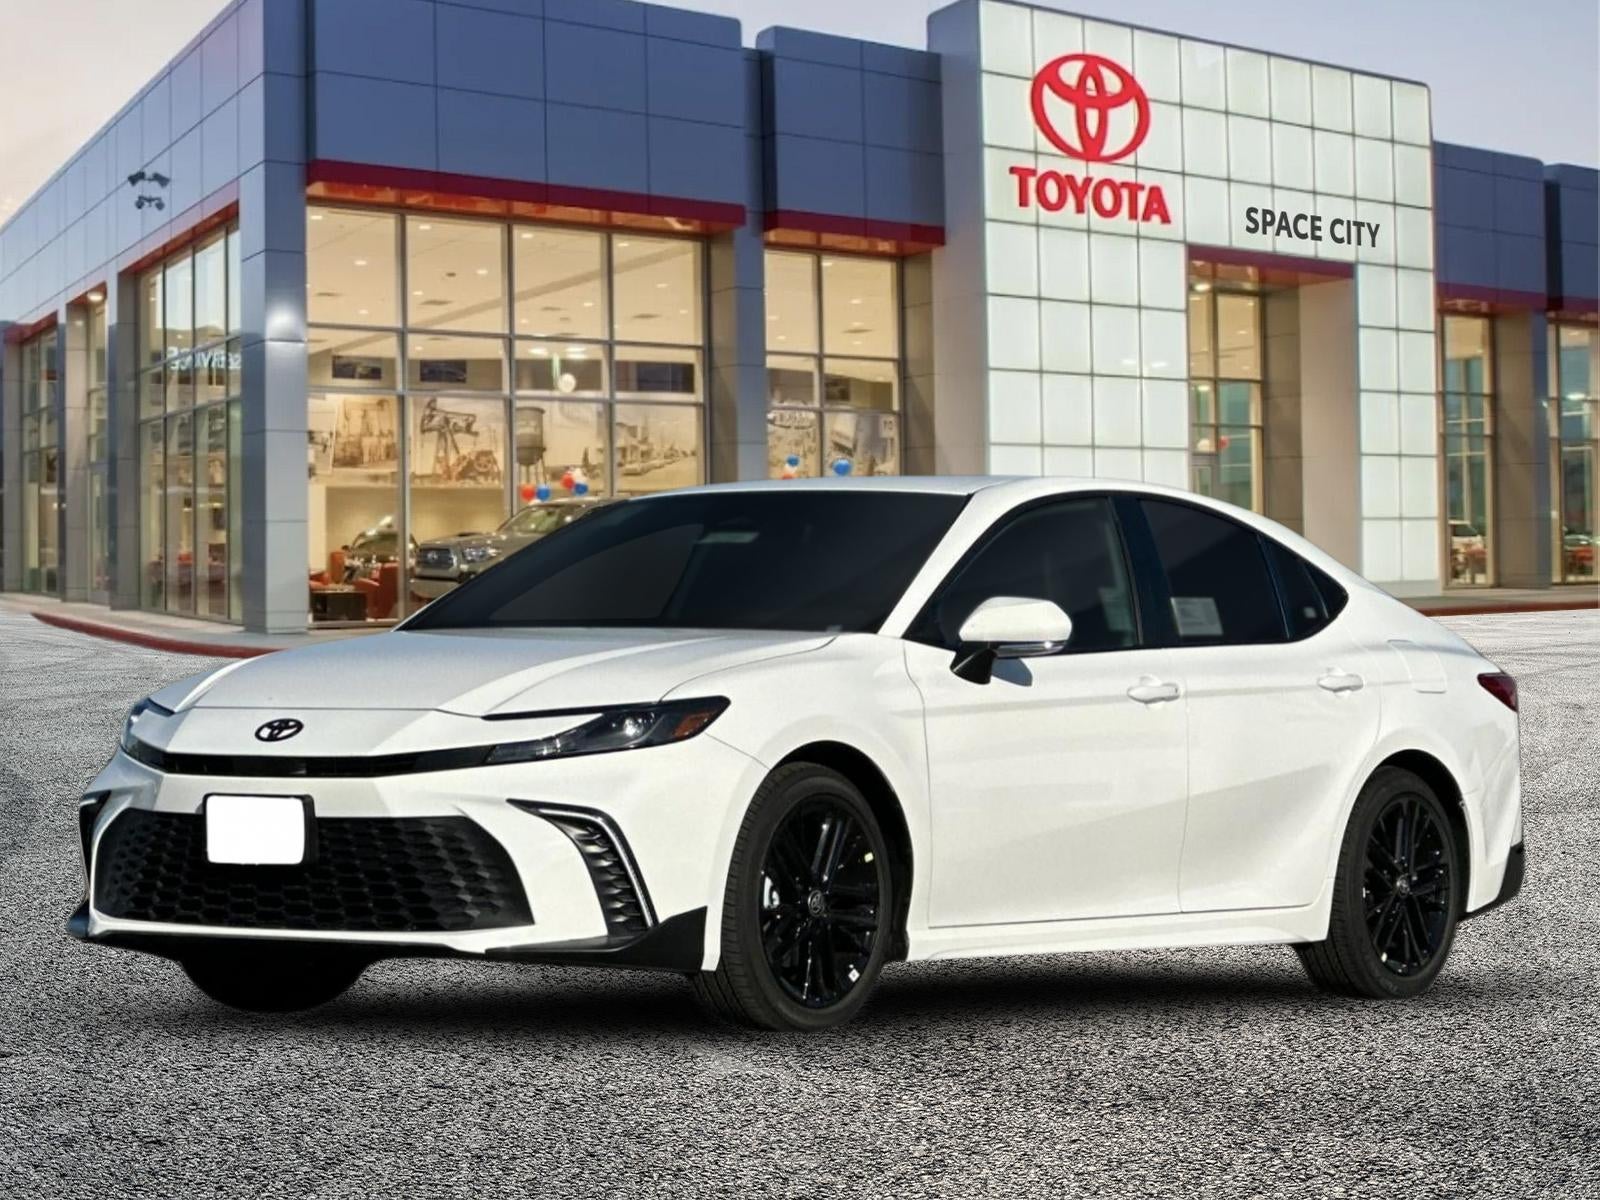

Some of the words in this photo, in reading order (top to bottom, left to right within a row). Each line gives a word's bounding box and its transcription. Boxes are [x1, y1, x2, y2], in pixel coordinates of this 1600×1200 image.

[1009, 165, 1172, 225] TOYOTA
[1245, 206, 1323, 242] SPACE
[1329, 218, 1381, 248] CITY
